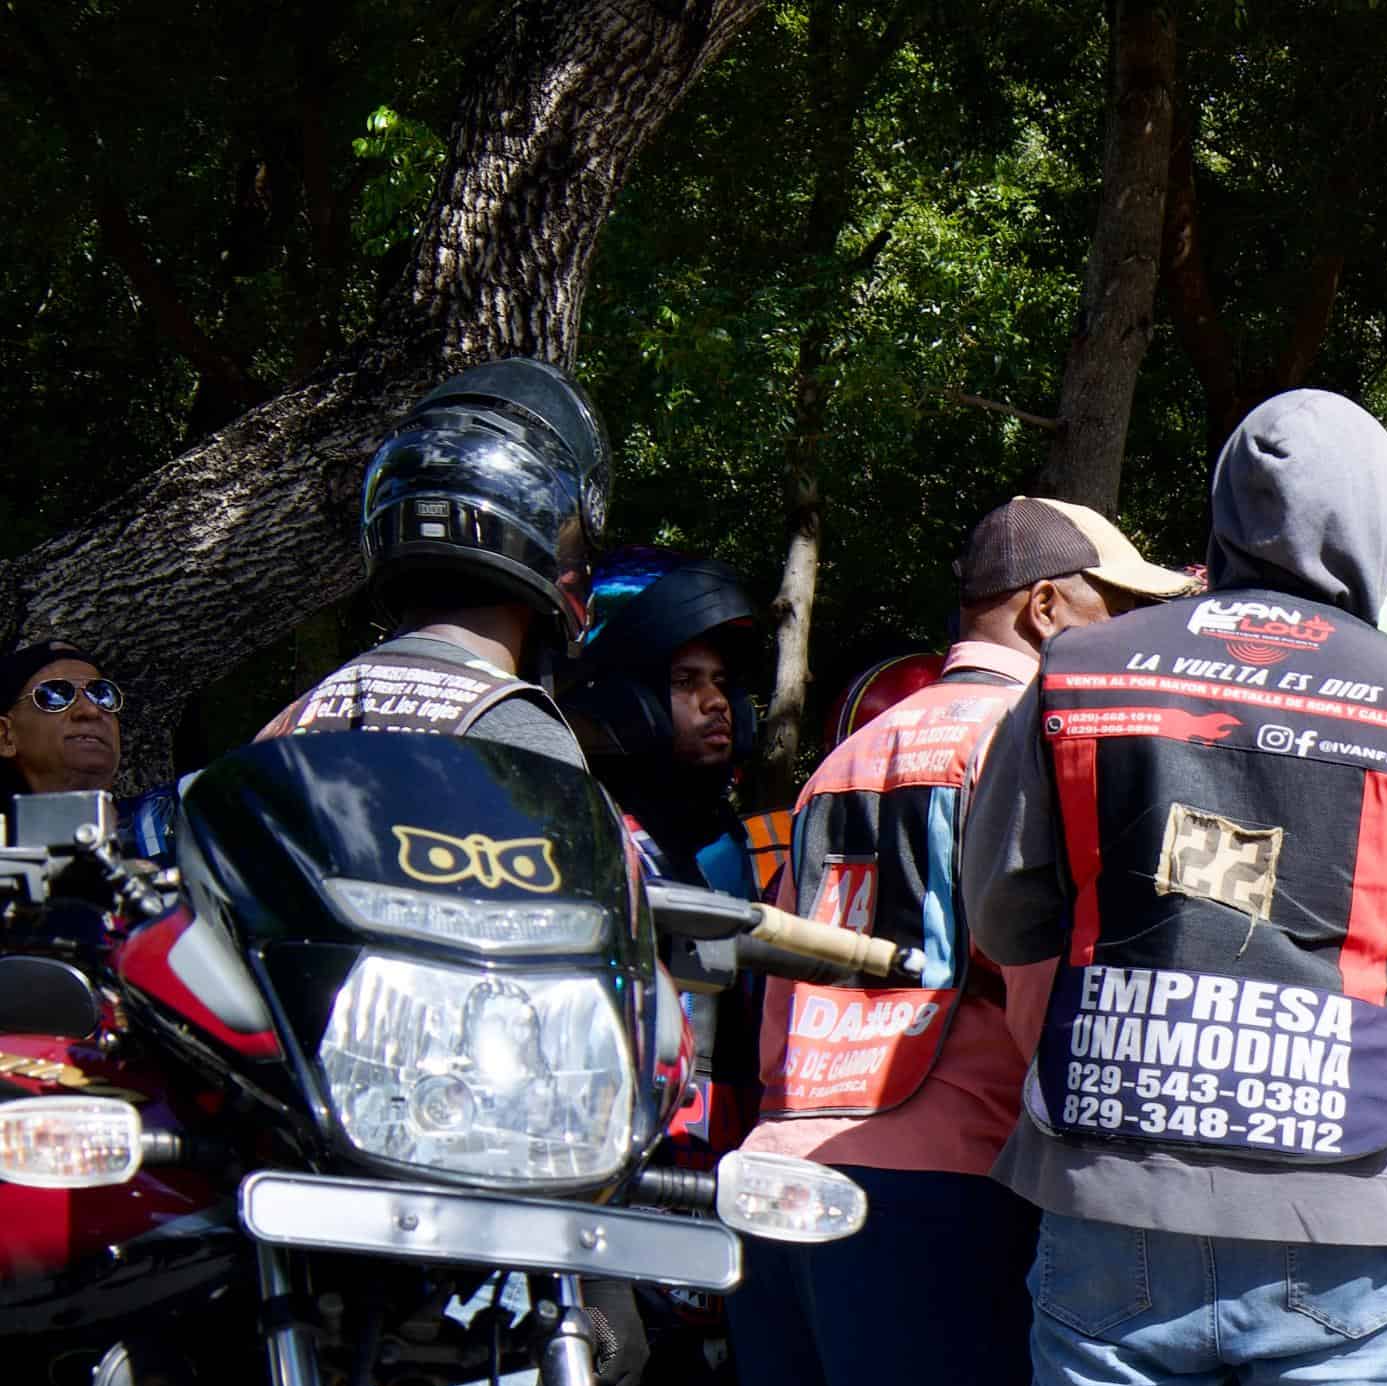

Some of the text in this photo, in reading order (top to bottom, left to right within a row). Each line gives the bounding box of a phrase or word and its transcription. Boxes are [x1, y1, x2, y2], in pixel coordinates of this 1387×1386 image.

[1066, 677, 1107, 687] VENTA
[1109, 677, 1126, 687] AL
[1129, 677, 1156, 688] POR
[1159, 679, 1207, 694] MAYOR
[1210, 687, 1221, 696] Y
[1222, 689, 1281, 706] DETALLE
[1285, 698, 1303, 709] DE
[1306, 701, 1343, 714] ROPA
[1345, 707, 1357, 716] Y
[1127, 653, 1384, 703] LA VUELTA ES DIOS
[1080, 966, 1353, 1043] EMPRESA
[1070, 1013, 1352, 1089] UNAMODINA
[1067, 1061, 1346, 1120] 829-543-0380
[1062, 1094, 1345, 1154] 829-348-2112
